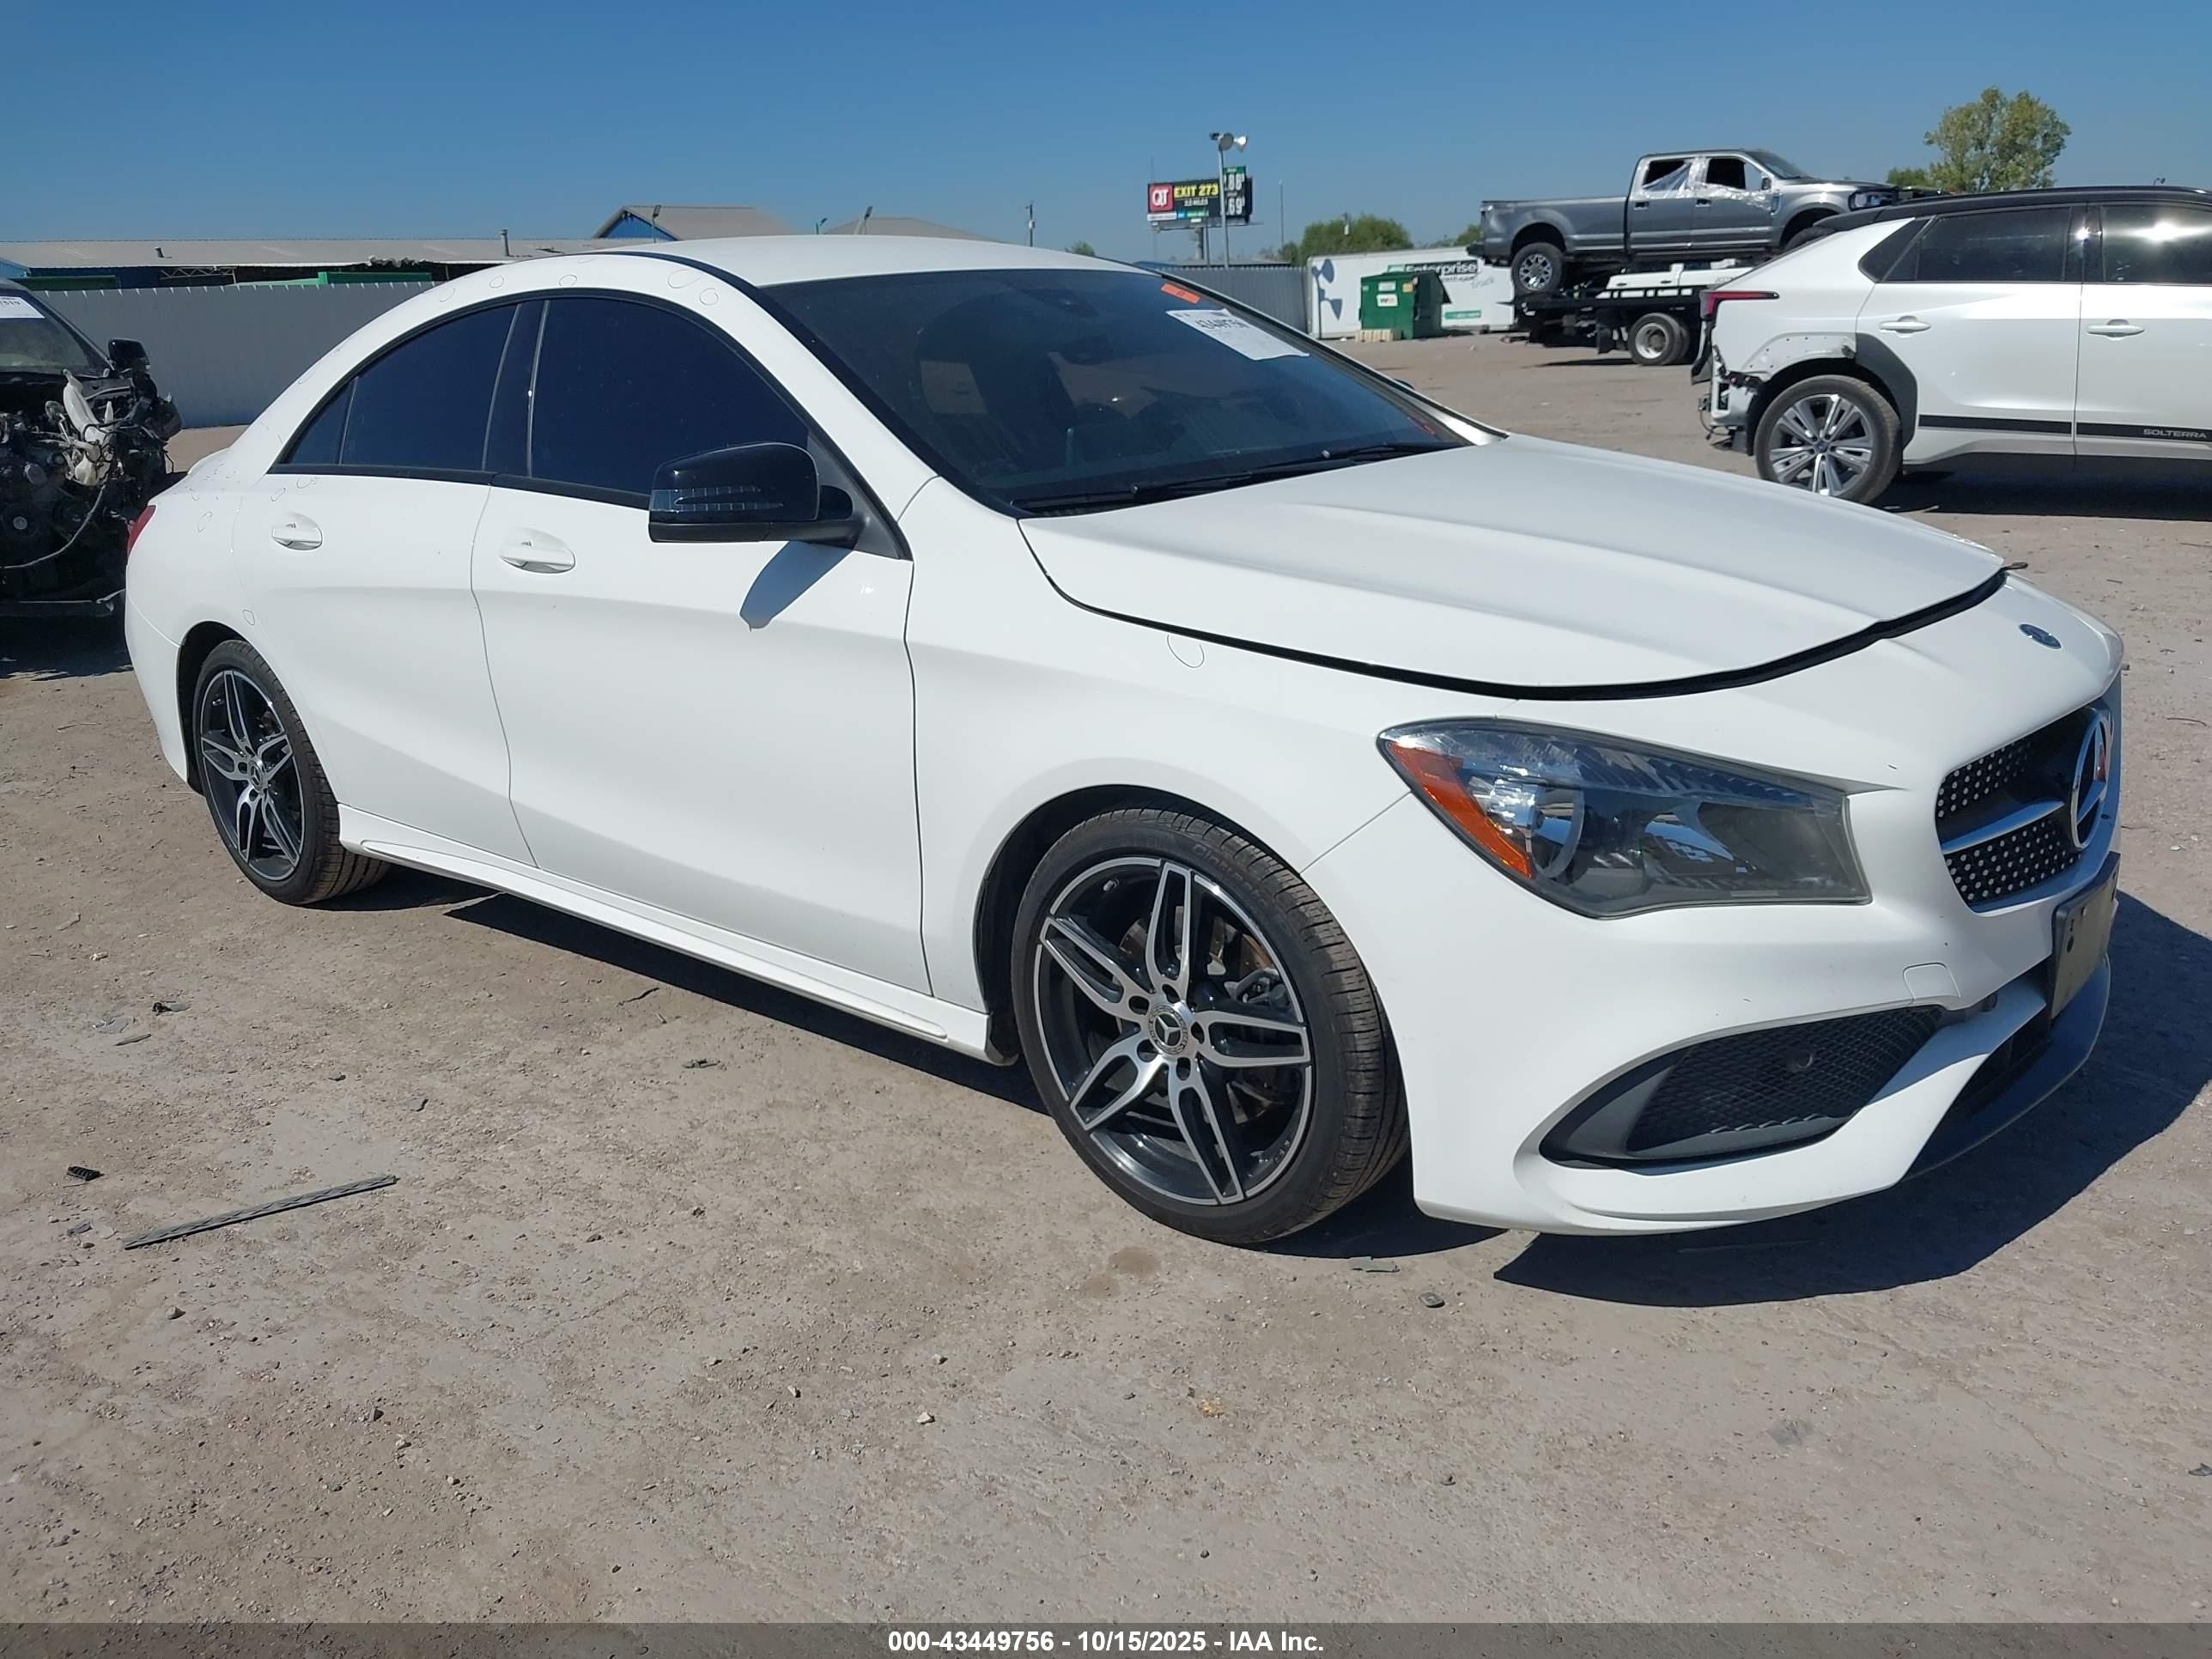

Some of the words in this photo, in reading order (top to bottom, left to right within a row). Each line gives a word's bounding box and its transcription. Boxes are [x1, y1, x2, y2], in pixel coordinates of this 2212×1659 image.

[1174, 185, 1197, 198] EXIT
[1199, 183, 1218, 197] 273
[2143, 428, 2207, 439] SOLTERRA
